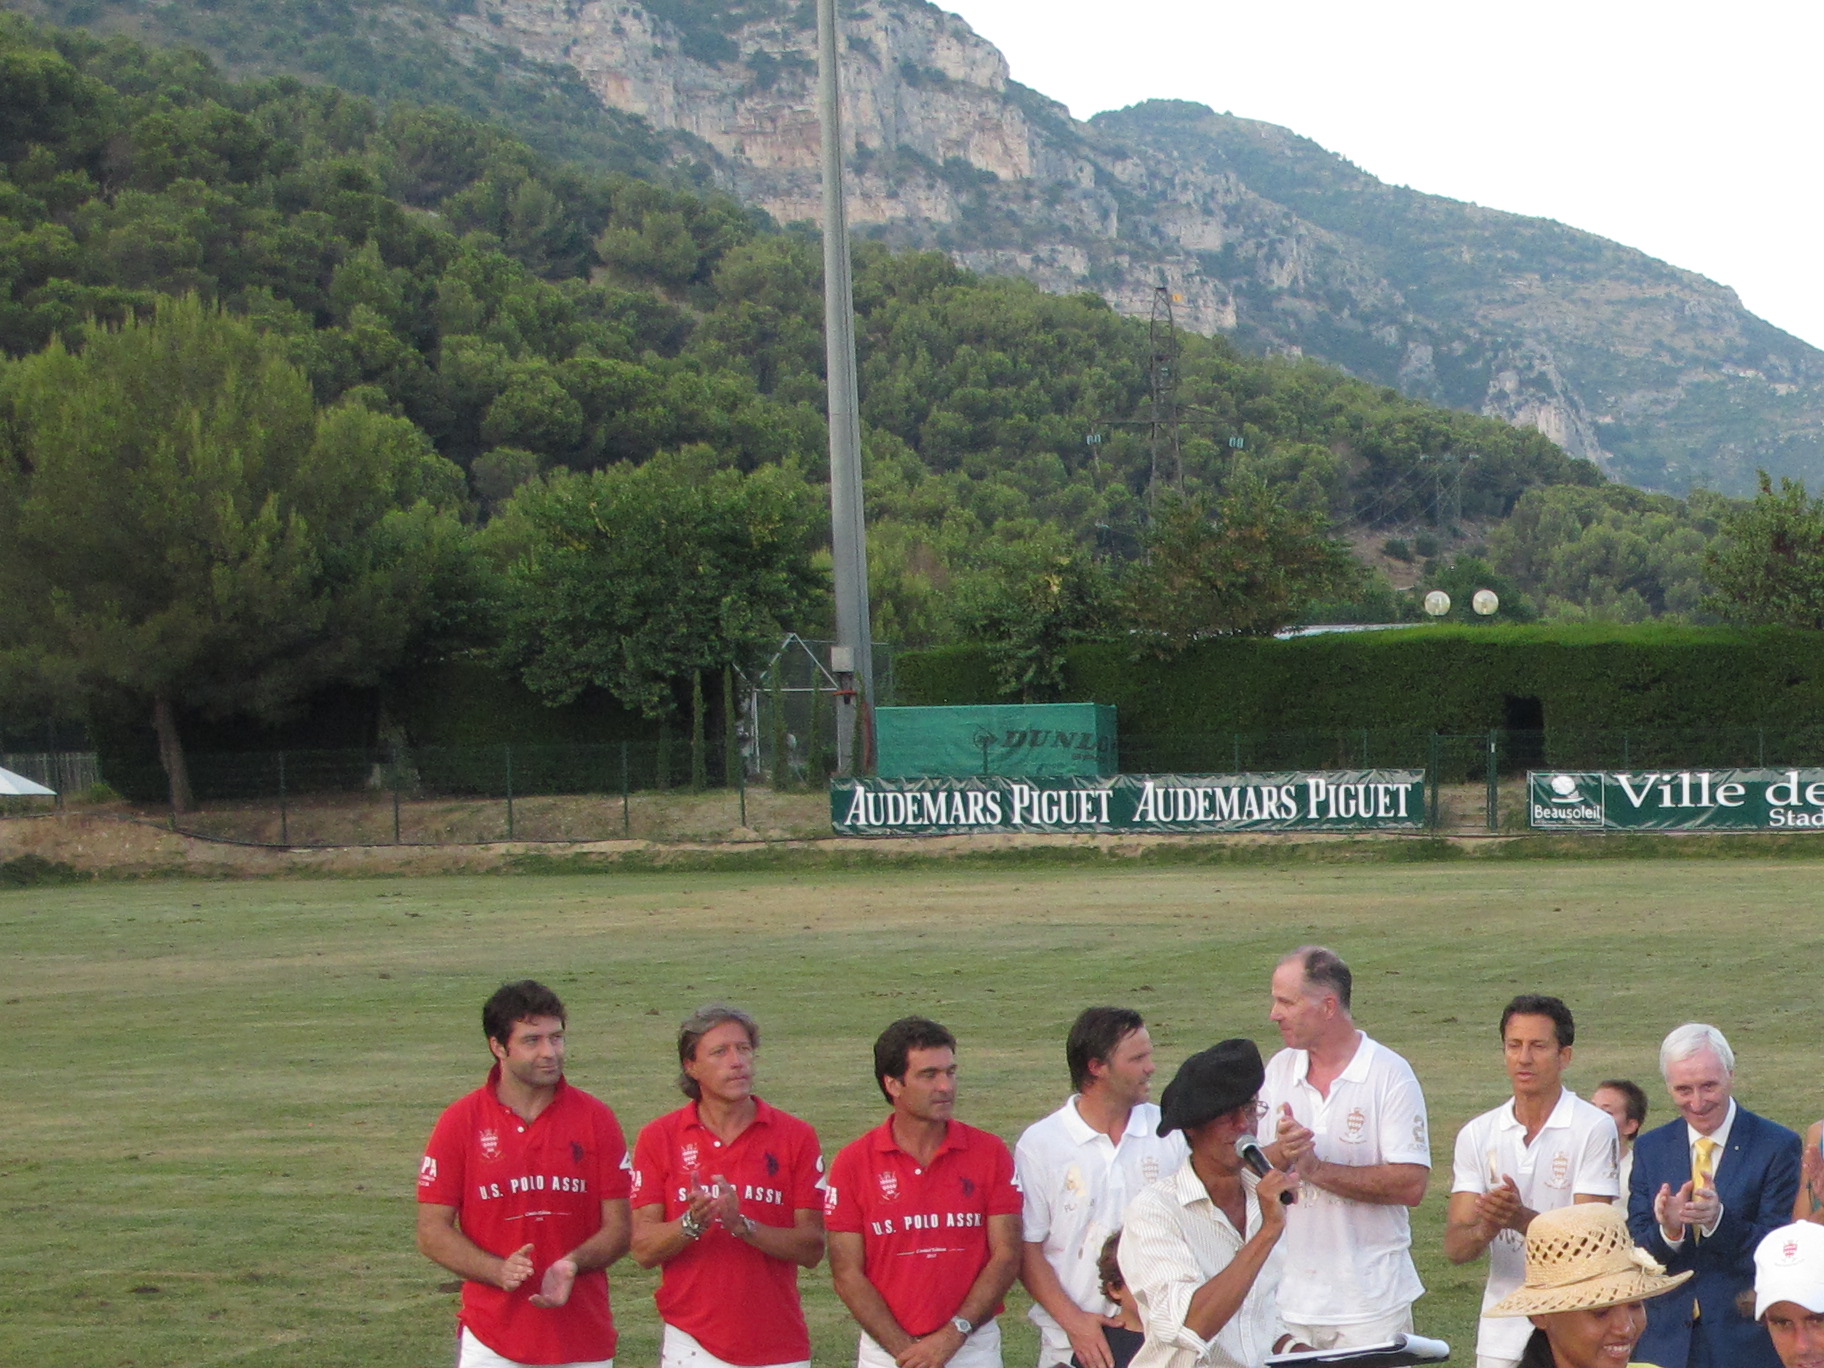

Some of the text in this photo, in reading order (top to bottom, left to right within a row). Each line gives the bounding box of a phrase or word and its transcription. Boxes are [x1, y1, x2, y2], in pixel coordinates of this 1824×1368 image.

[845, 783, 1114, 826] AUDEMARS PIGUET
[1132, 778, 1412, 823] AUDEMARS PIGUET
[1613, 772, 1747, 808] Ville
[1534, 804, 1601, 819] Beausoleil
[479, 1184, 504, 1200] U.S.
[510, 1175, 545, 1194] POLO
[872, 1219, 897, 1236] U.S.
[904, 1213, 939, 1231] POLO
